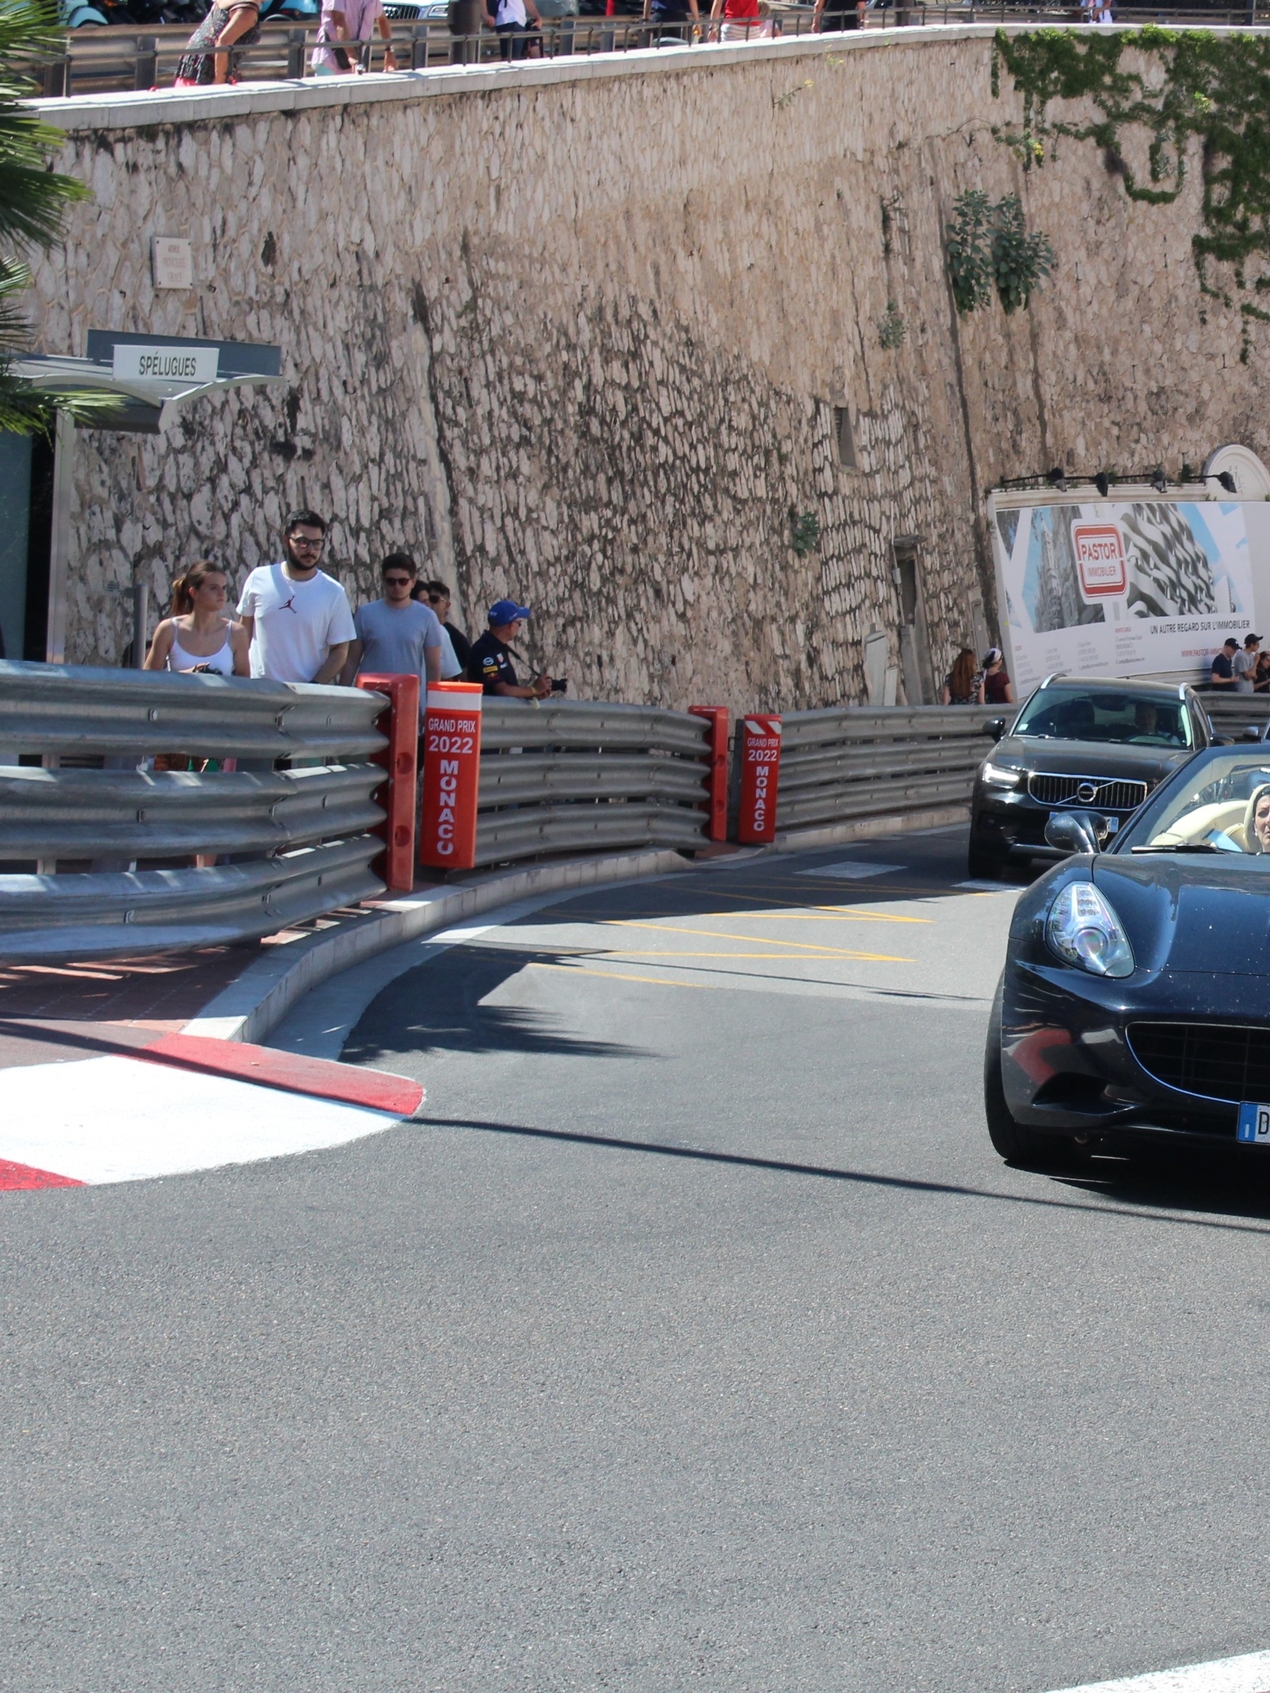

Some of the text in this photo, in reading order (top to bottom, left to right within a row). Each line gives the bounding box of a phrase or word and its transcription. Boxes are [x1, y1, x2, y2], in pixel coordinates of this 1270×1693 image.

[139, 351, 197, 376] SPÉLUGUES
[1081, 542, 1117, 561] PASTOR
[1150, 620, 1250, 635] UN AUTRE REGARD SUR L'IMMOBILIER
[428, 717, 476, 733] GRAND PRIX
[428, 735, 473, 754] 2022
[747, 737, 779, 747] GRAND PRIX
[748, 749, 777, 761] 2022
[436, 759, 459, 855] MONACO
[753, 766, 769, 831] MONACO
